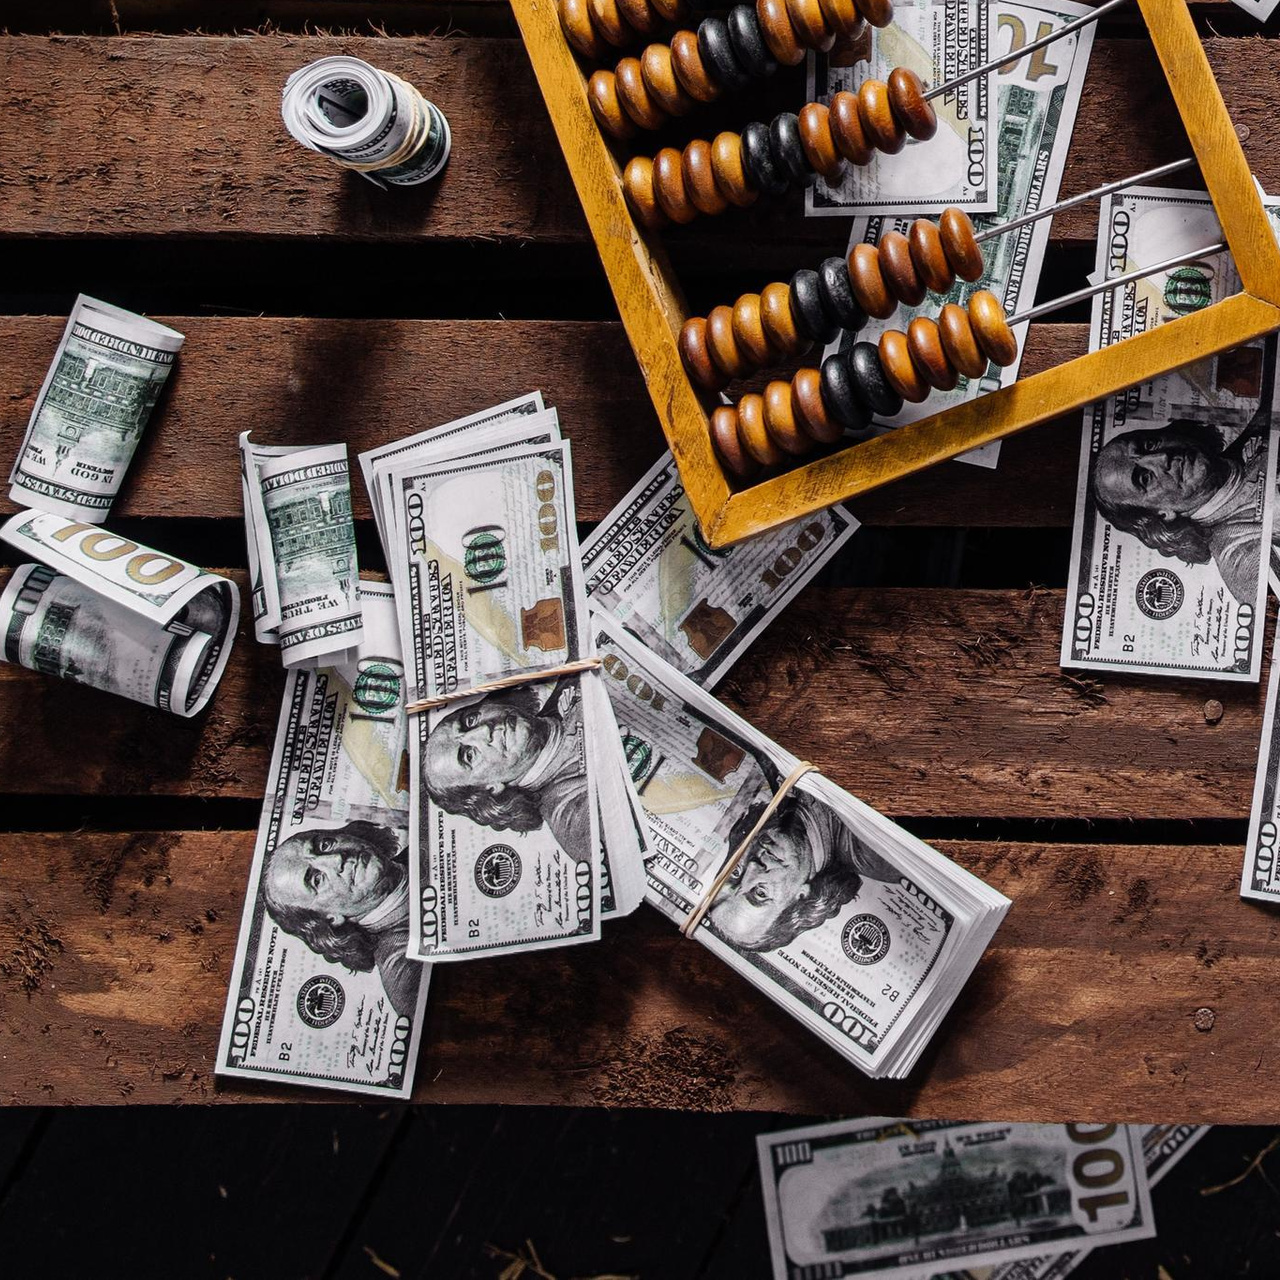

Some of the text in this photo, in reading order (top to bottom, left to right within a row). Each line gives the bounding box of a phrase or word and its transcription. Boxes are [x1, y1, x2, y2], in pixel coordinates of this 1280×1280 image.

[967, 125, 985, 187] 100
[1108, 209, 1131, 272] 100
[407, 490, 426, 556] 100
[534, 466, 560, 554] 100
[1093, 522, 1111, 650] FEDERAL RESERVE NOTE
[1074, 591, 1095, 655] 100
[1121, 632, 1135, 652] B2
[1233, 601, 1254, 663] 100
[436, 809, 447, 942] FEDERAL RESERVE NOTE
[1254, 820, 1278, 885] 100
[420, 882, 439, 949] 100
[574, 858, 593, 922] 100
[897, 875, 946, 918] 100
[466, 917, 480, 938] B2
[249, 924, 279, 1057] FEDERAL RESERVE NOTE
[776, 947, 879, 1028] FEDERAL RESERVE NOTE
[880, 983, 899, 1002] B2
[230, 996, 257, 1062] 100
[277, 1041, 293, 1062] B2
[385, 1013, 412, 1079] 100
[821, 998, 876, 1047] 100
